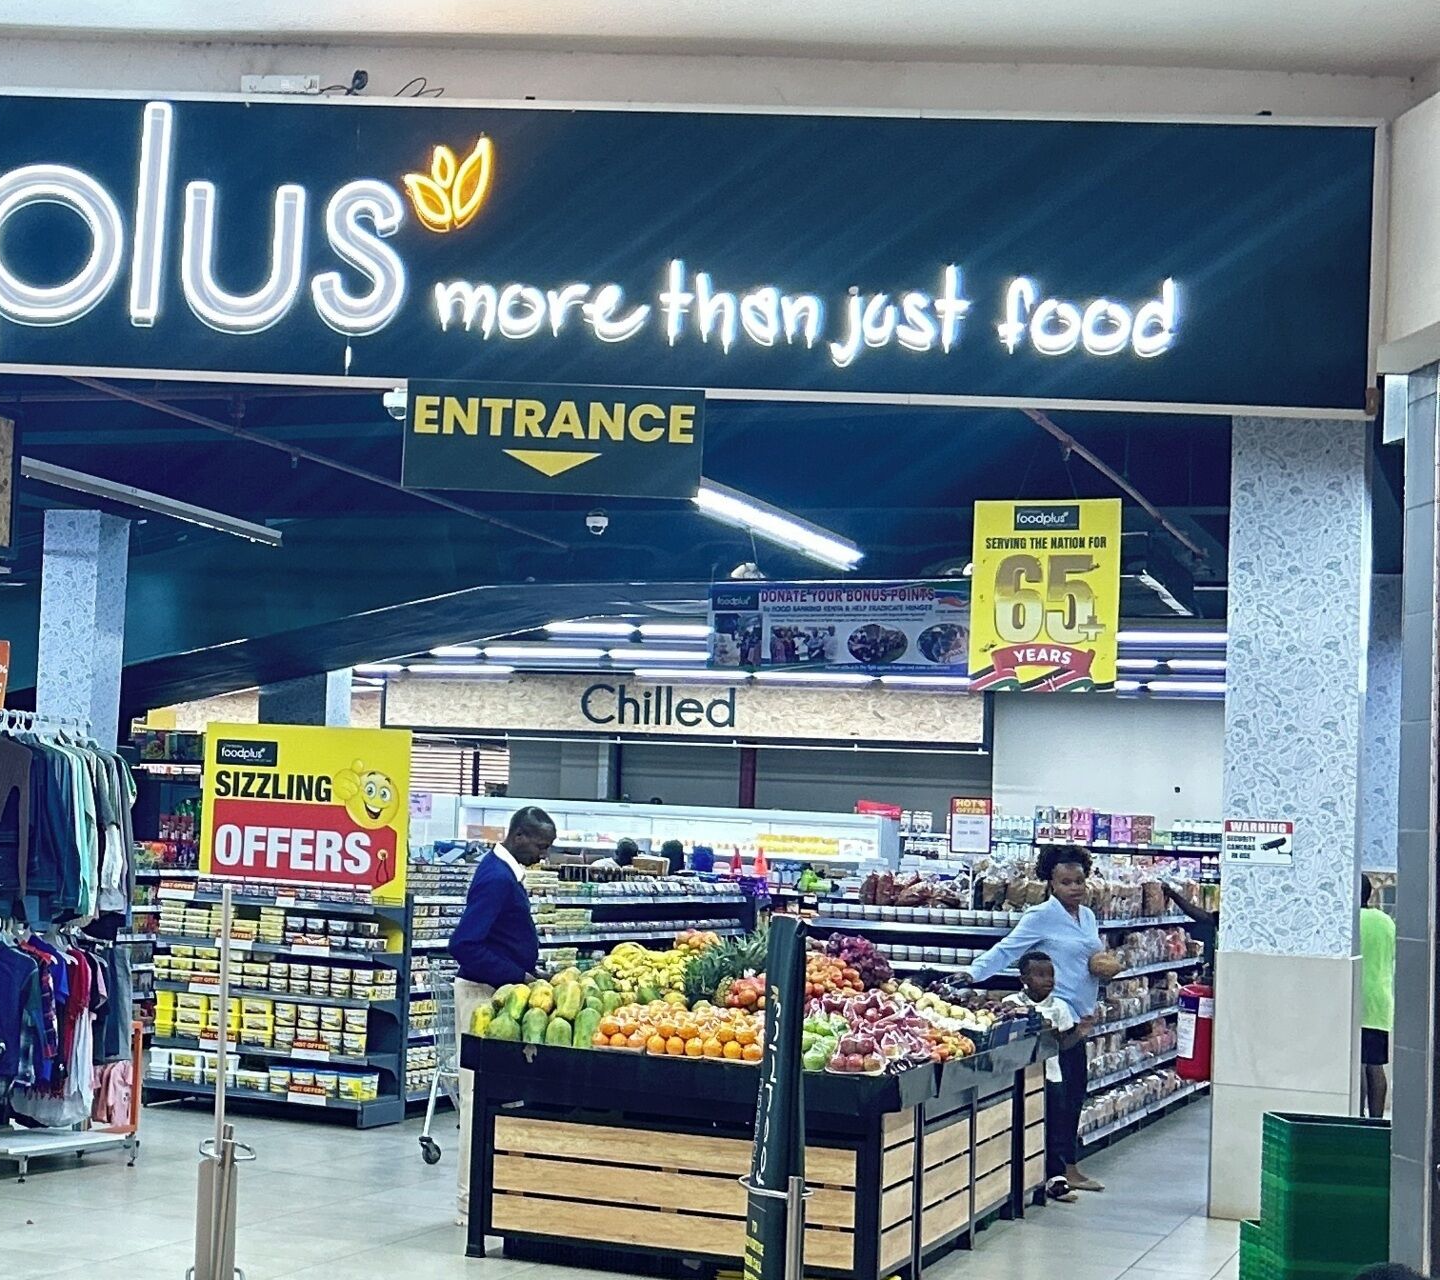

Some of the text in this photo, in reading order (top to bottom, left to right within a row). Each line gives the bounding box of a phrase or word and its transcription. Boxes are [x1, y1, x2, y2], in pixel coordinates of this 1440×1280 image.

[434, 259, 1178, 368] more than just food
[414, 395, 695, 444] ENTRANCE
[1017, 512, 1065, 525] foodplus
[985, 536, 1107, 549] SERVING THE NATION FOR
[760, 588, 935, 603] DONATE YOUR BONUS POINTS
[1013, 649, 1072, 665] YEARS
[581, 683, 736, 728] Chilled
[221, 746, 263, 759] foodplus
[215, 770, 332, 802] SIZZLING
[1230, 821, 1287, 834] WARNING
[1227, 835, 1256, 843] SECURITY
[215, 823, 372, 875] OFFERS
